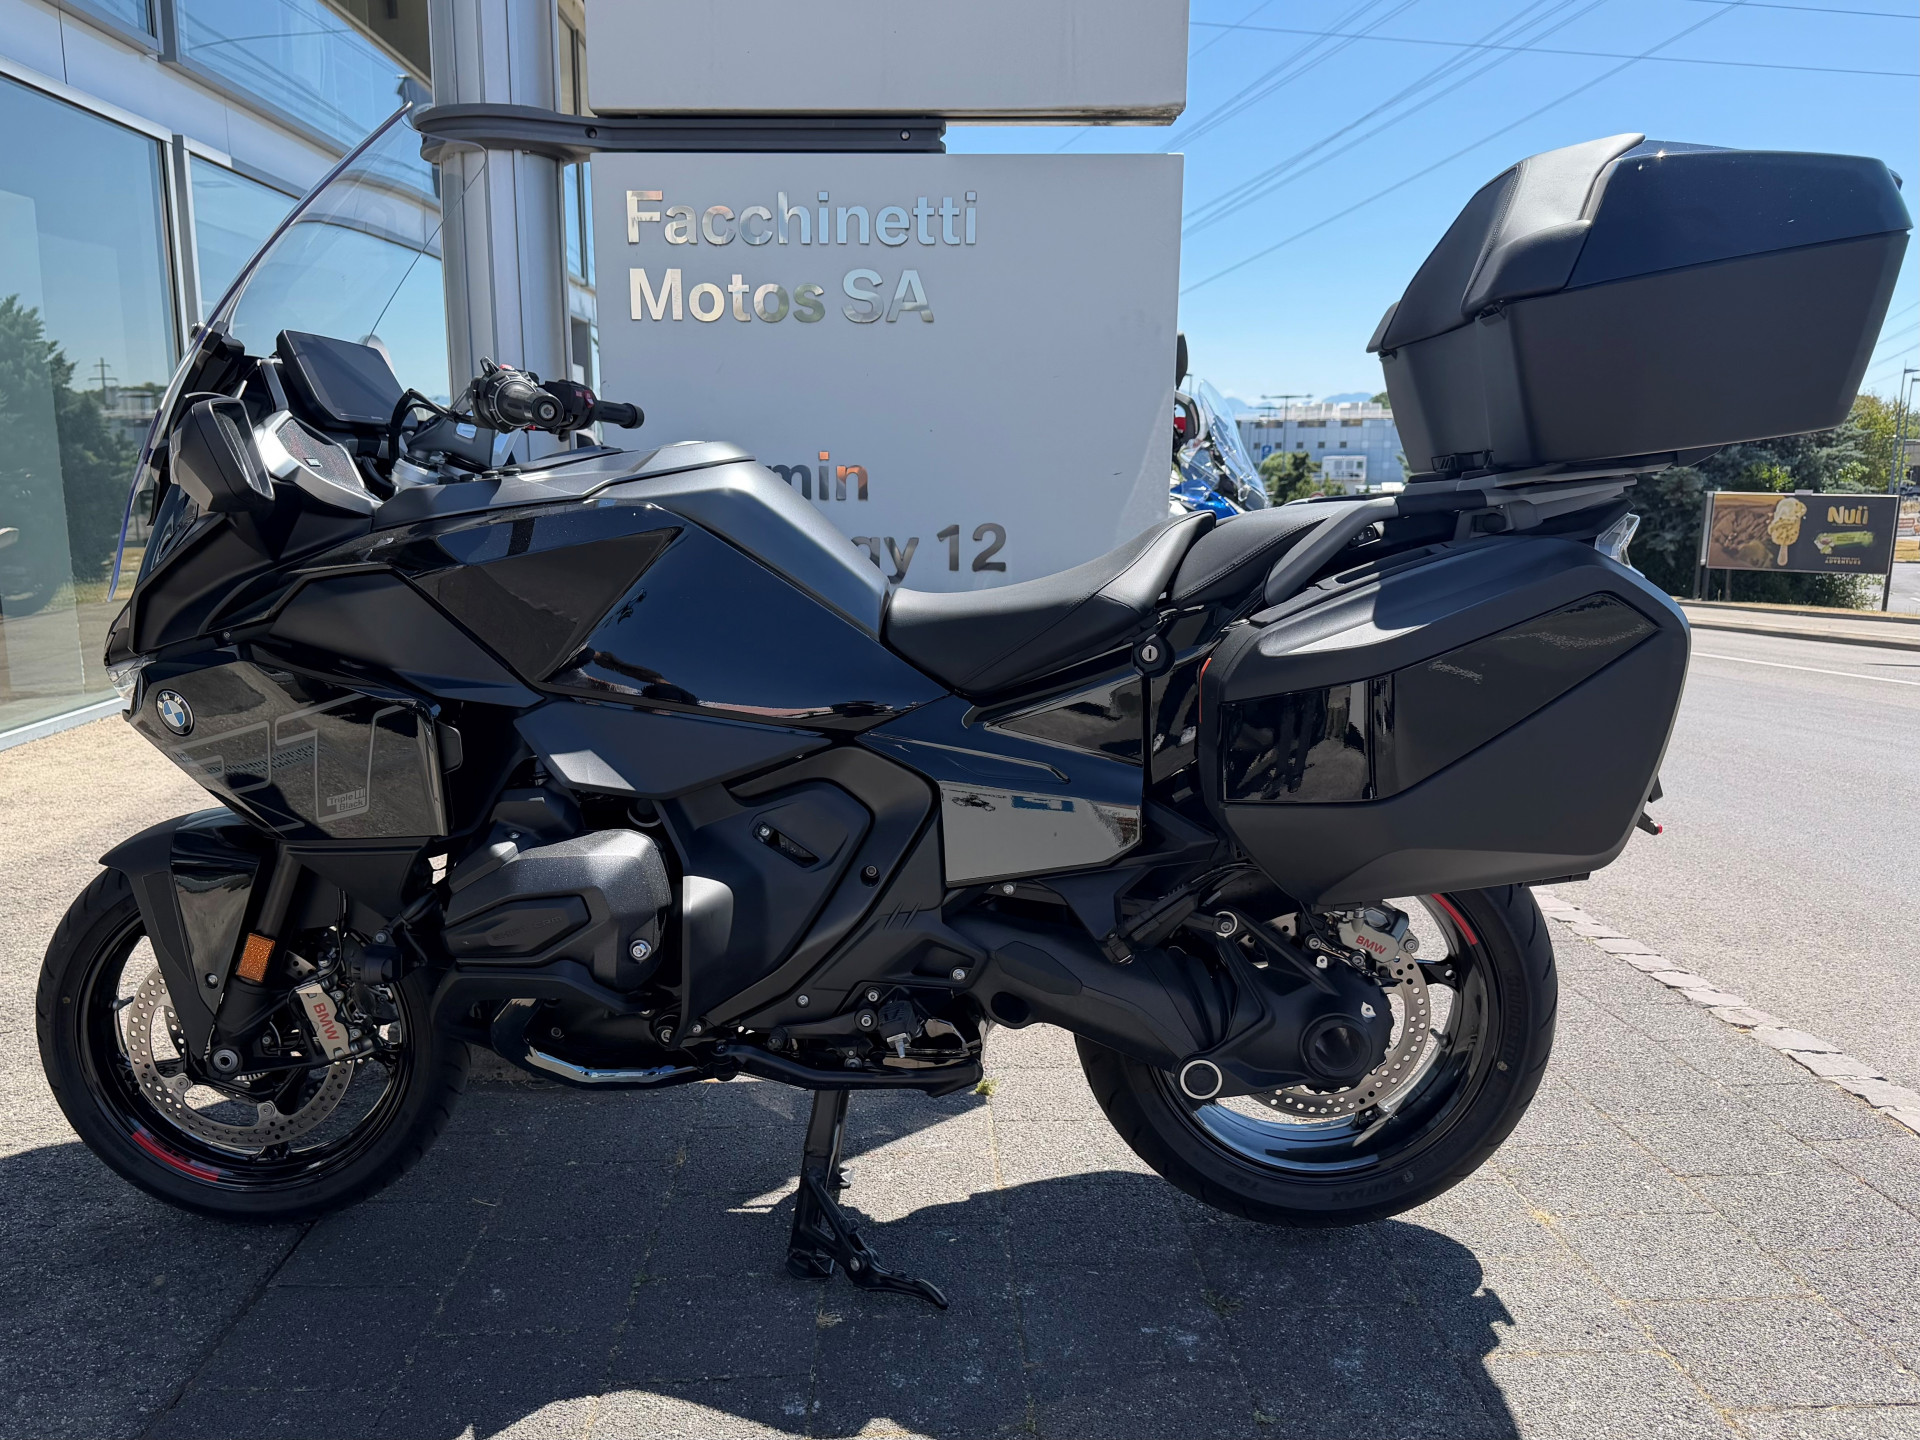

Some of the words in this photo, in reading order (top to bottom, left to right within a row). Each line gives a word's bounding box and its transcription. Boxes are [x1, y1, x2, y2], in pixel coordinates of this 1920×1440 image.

[626, 190, 977, 247] Facchinetti
[629, 267, 826, 324] Motos
[841, 268, 935, 324] SA
[936, 522, 1007, 573] 12
[157, 692, 182, 709] BMW
[1355, 934, 1387, 955] BMW
[313, 1002, 340, 1040] BMW
